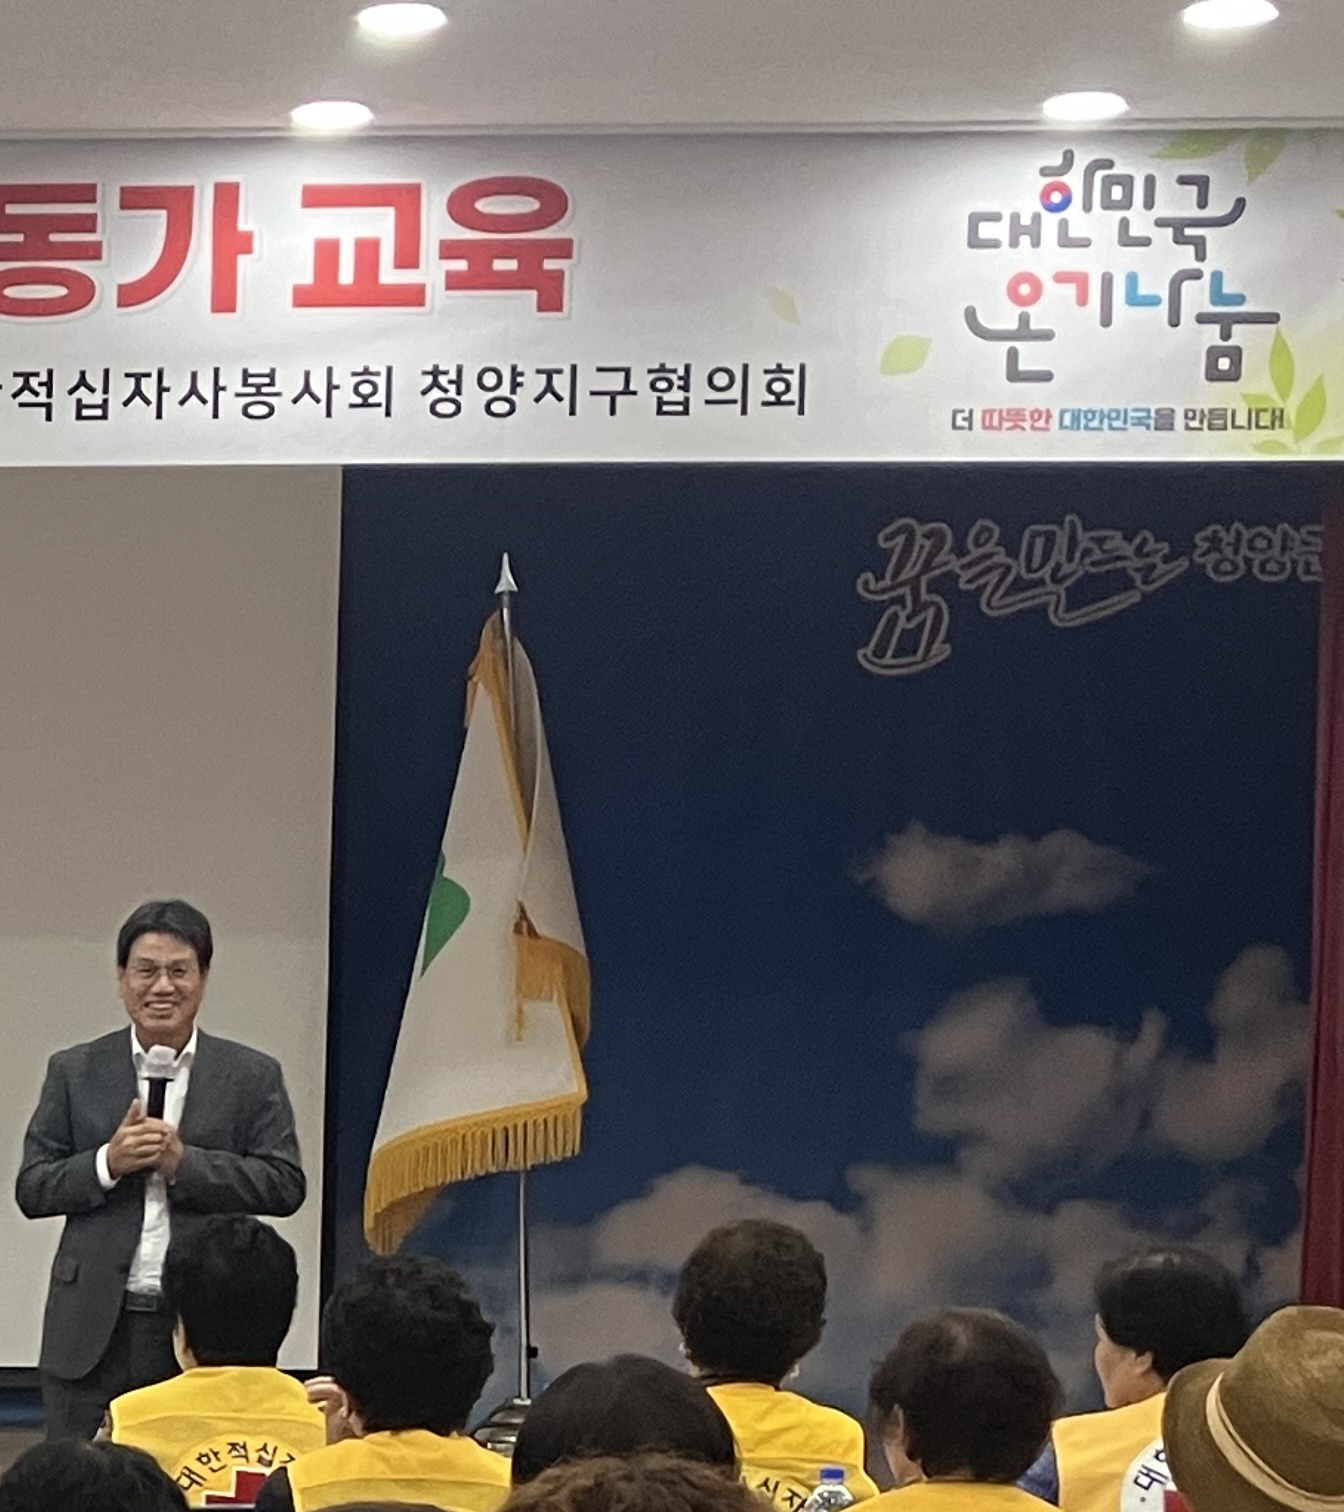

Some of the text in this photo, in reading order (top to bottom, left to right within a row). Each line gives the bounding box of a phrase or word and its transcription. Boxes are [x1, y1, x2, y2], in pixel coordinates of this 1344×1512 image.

[292, 176, 574, 313] 교육
[967, 149, 1247, 262] 대한민국
[964, 268, 1281, 383] 온기나눔
[420, 362, 806, 419] 청양지구협의회
[952, 407, 973, 431] 더
[981, 408, 1052, 432] 따뜻한
[1059, 407, 1175, 432] 대한민국을
[176, 1441, 296, 1490] 대한적십
